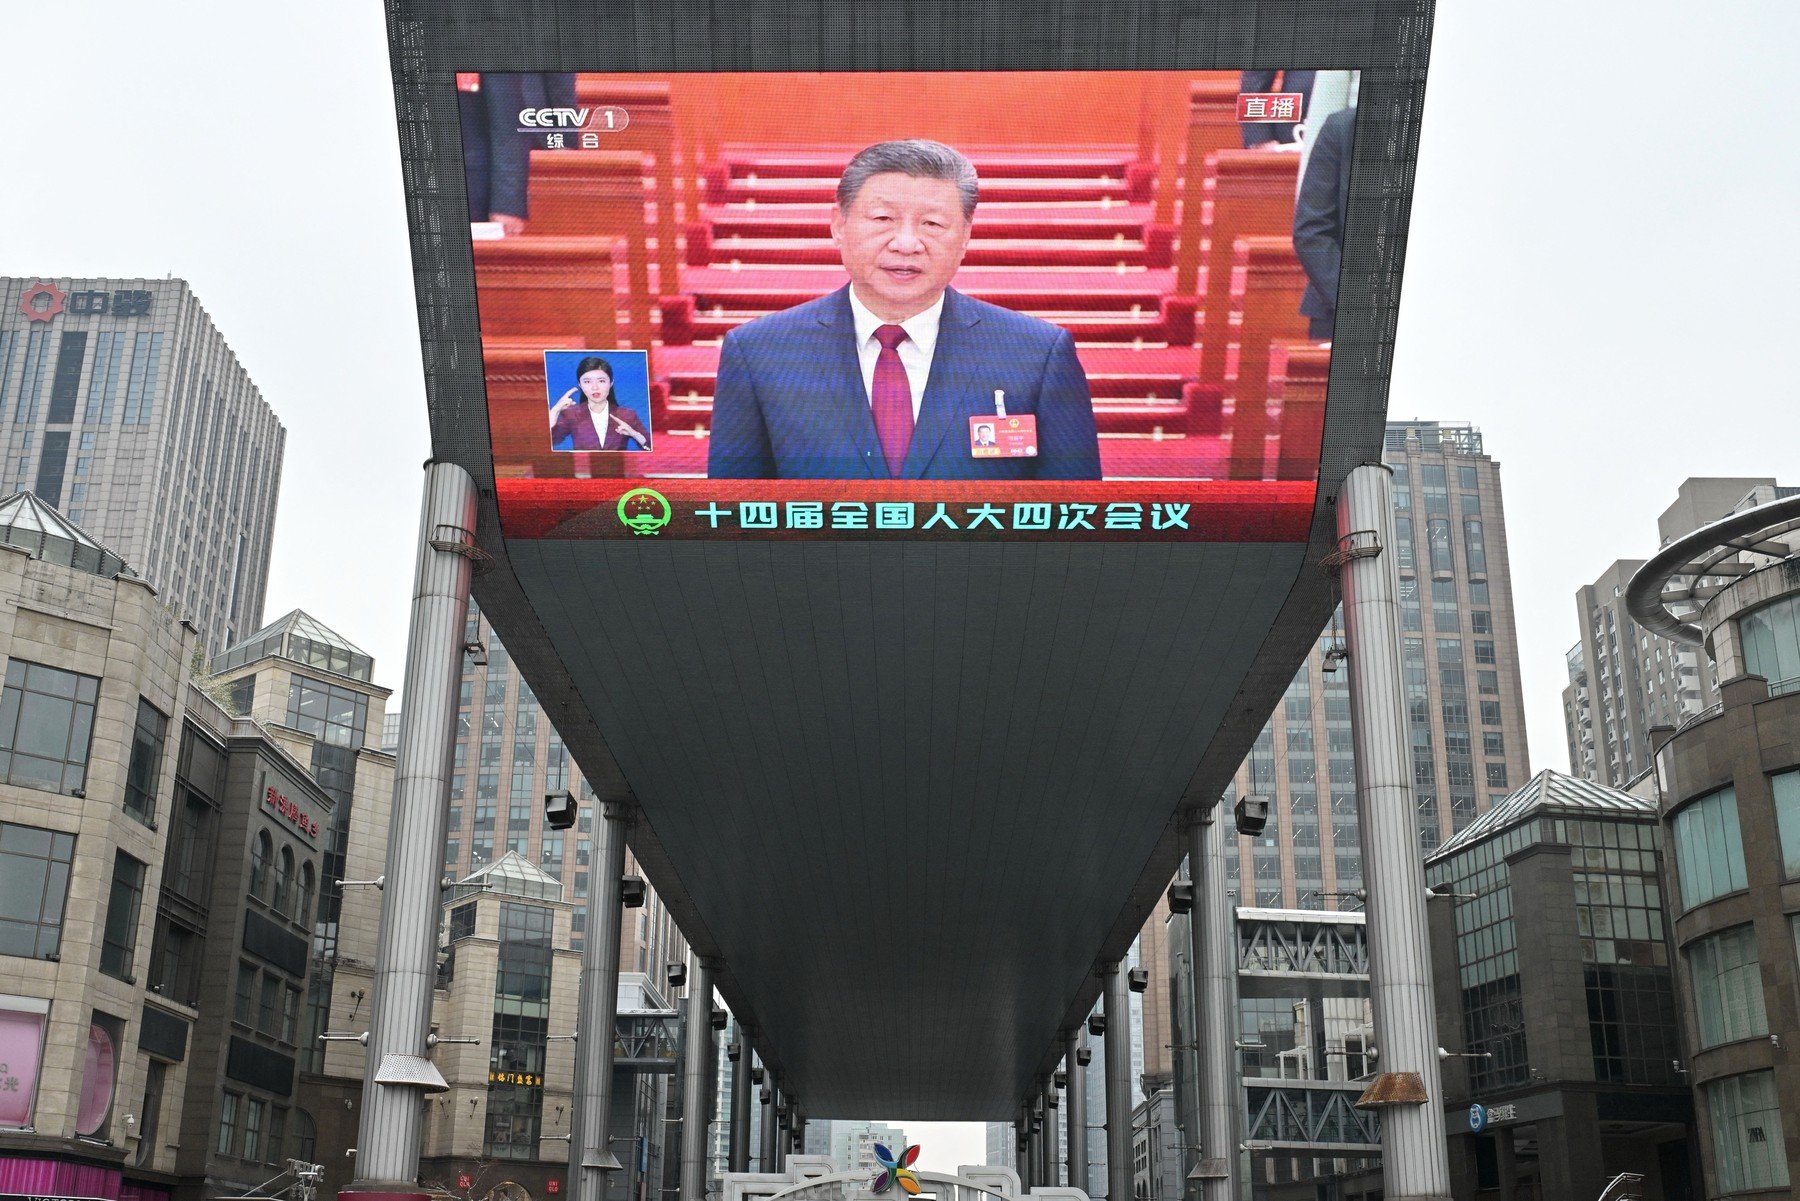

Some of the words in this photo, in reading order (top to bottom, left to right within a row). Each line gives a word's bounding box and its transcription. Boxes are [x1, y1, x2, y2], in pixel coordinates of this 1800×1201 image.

[1244, 97, 1294, 117] 直播
[519, 108, 589, 126] CCTV
[604, 110, 614, 128] 1
[547, 133, 598, 148] 综合
[695, 502, 1190, 530] 十四届全国人大四次会议
